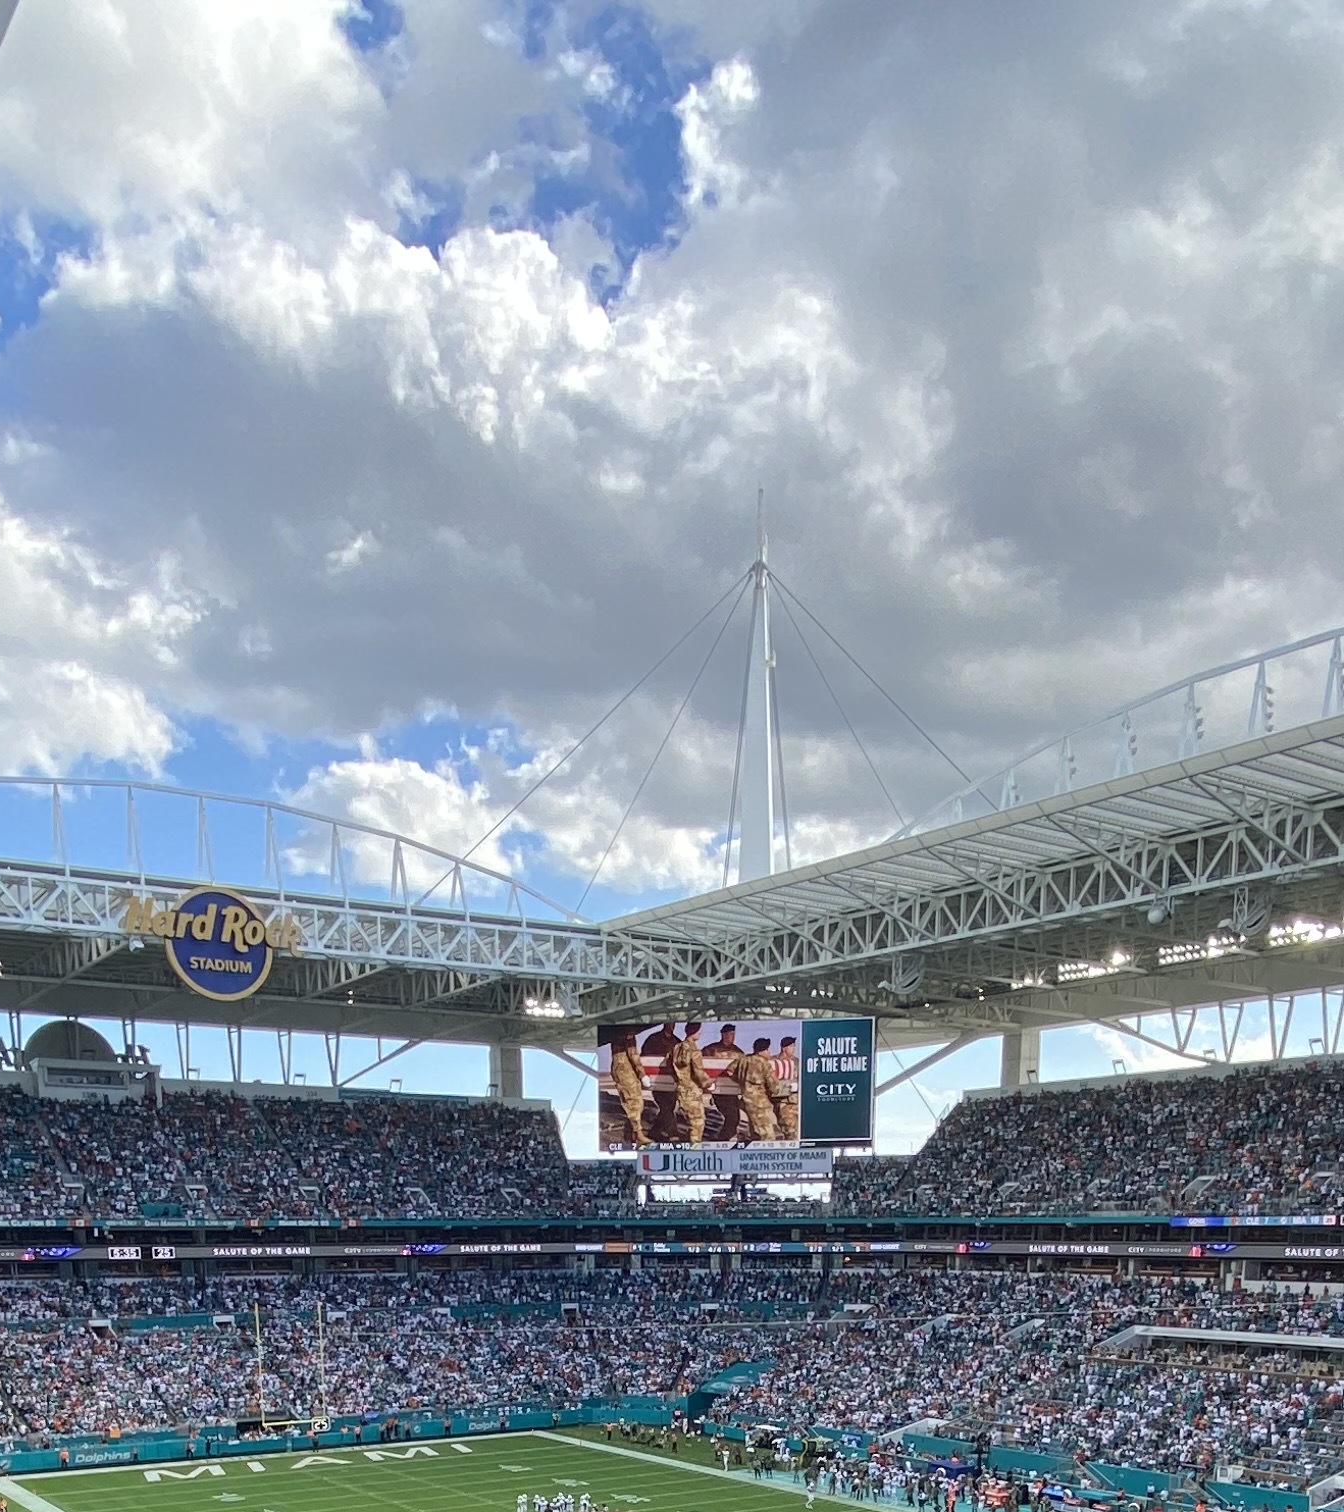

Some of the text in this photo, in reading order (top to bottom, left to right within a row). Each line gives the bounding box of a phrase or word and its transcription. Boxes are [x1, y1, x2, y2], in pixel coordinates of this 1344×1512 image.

[124, 895, 304, 958] Hard Rock
[189, 956, 253, 974] STADIUM
[817, 1036, 857, 1055] SALUTE
[807, 1055, 868, 1073] OF THE GAME
[816, 1083, 856, 1096] CITY
[659, 1142, 674, 1150] MIA
[739, 1152, 826, 1161] UNIVERSITY OF MIAMI
[739, 1162, 803, 1171] HEALTH SYSTEM
[157, 1247, 171, 1257] 25
[266, 1247, 282, 1255] THE
[285, 1247, 311, 1255] GAME
[504, 1244, 520, 1252] THE
[1028, 1244, 1109, 1253] SALUTE OF THE GAME
[1284, 1248, 1321, 1257] SALUTE
[1324, 1248, 1340, 1257] OF
[314, 1419, 328, 1430] 25
[75, 1450, 131, 1464] Dolphins
[143, 1443, 473, 1482] MIAMI
